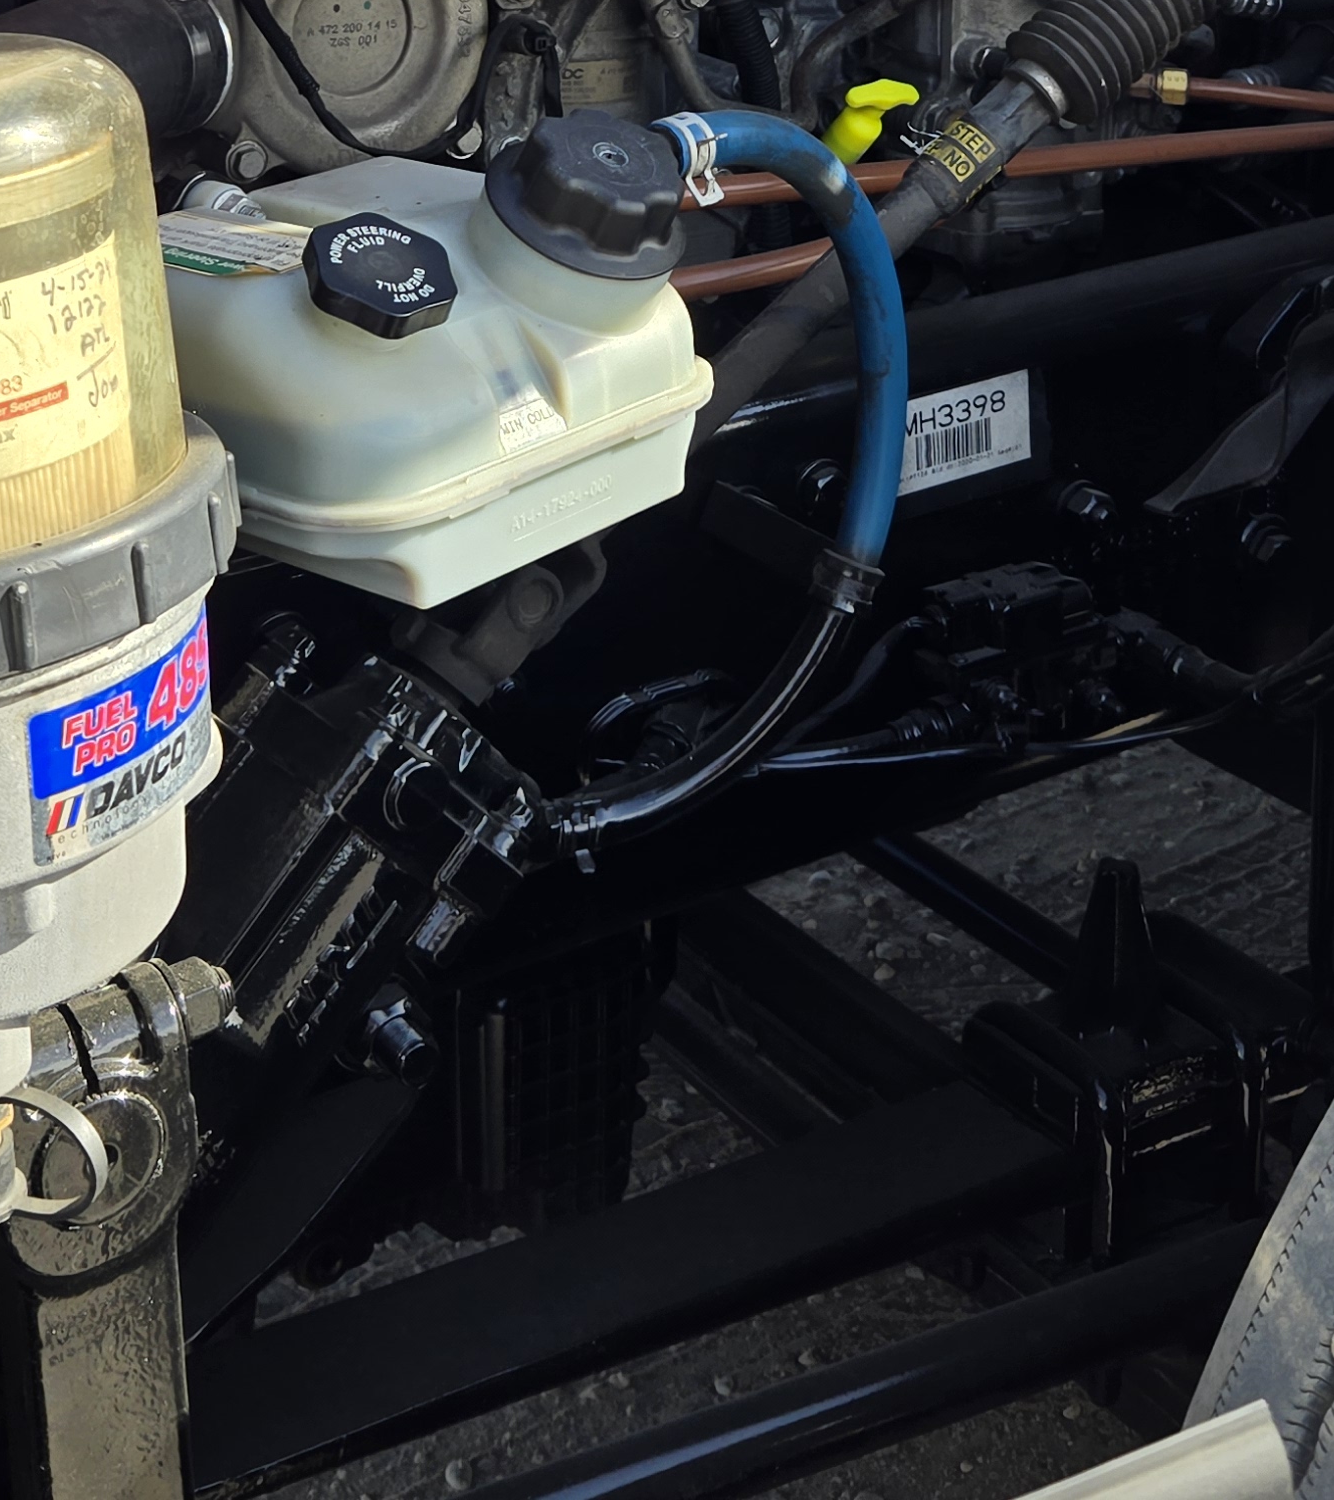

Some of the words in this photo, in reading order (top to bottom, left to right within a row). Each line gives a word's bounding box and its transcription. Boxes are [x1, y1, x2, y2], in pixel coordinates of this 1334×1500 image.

[306, 25, 315, 37] A
[319, 23, 338, 34] 472
[341, 21, 361, 32] 200
[366, 20, 381, 31] 14
[385, 18, 398, 29] 15
[950, 122, 991, 156] STEP
[943, 148, 971, 177] NO
[329, 233, 351, 264] POWER
[346, 225, 412, 244] STEERING
[346, 236, 385, 253] FLUID
[375, 267, 425, 293] OVERFILL
[418, 283, 436, 298] DO
[393, 292, 419, 303] NOT
[9, 388, 64, 414] Separator
[62, 690, 138, 749] FUEL
[72, 721, 137, 777] PRO
[85, 730, 187, 820] DAVCO
